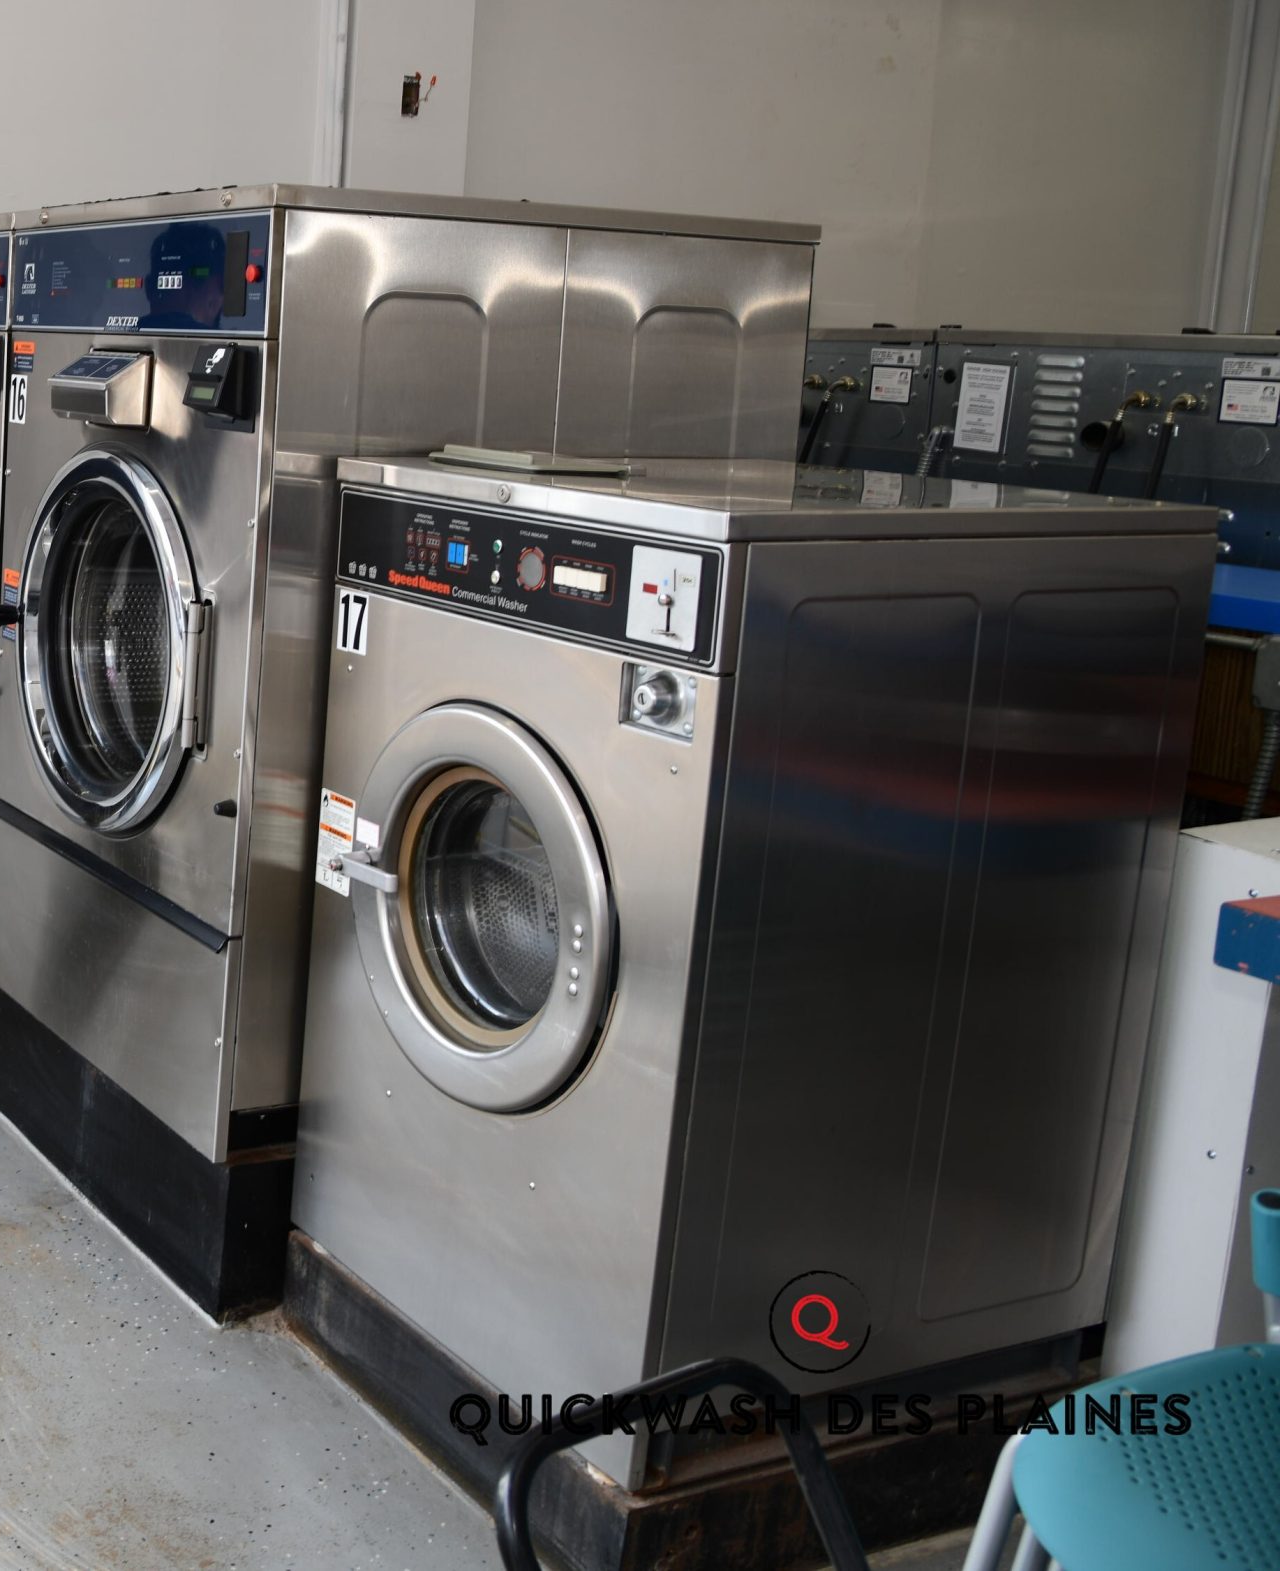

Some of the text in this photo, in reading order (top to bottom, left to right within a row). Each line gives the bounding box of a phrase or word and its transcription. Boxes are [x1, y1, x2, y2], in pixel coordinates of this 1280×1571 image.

[106, 316, 139, 327] DEXTER
[11, 377, 26, 420] 16
[388, 570, 419, 588] Speed
[418, 576, 450, 595] Queen
[451, 585, 497, 605] Commercial
[497, 596, 528, 613] Washer
[341, 593, 367, 651] 17
